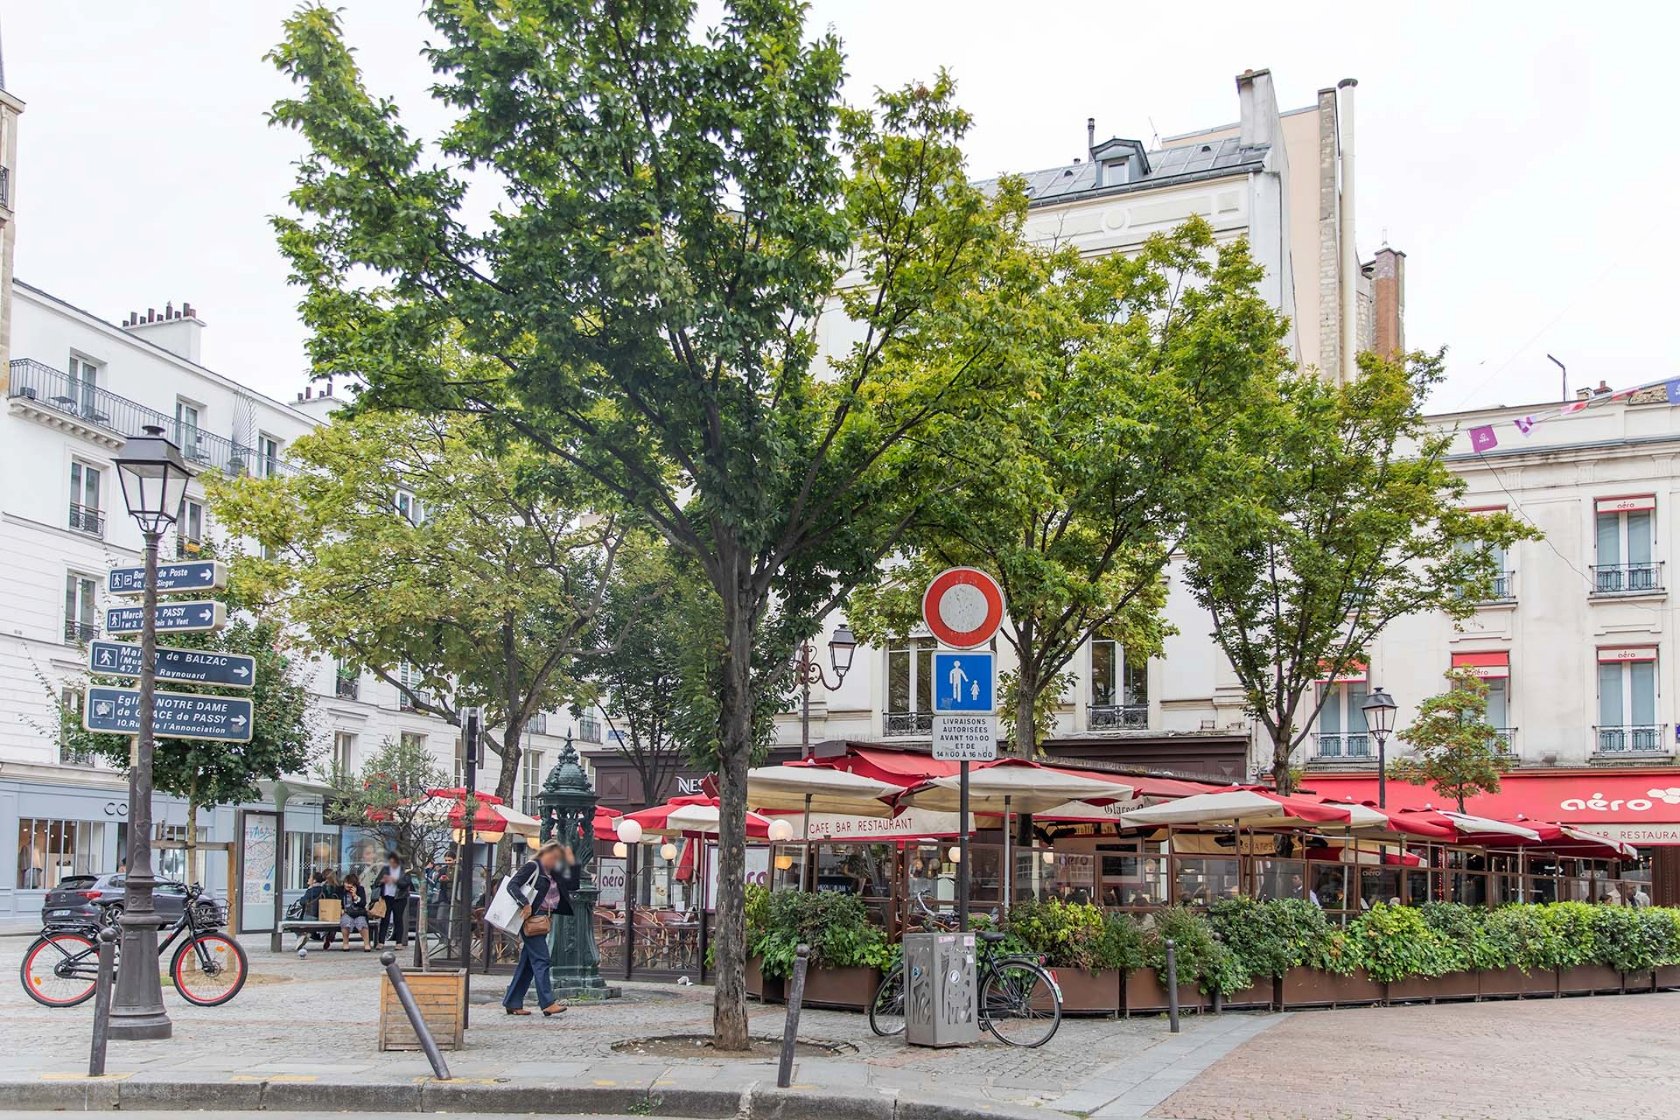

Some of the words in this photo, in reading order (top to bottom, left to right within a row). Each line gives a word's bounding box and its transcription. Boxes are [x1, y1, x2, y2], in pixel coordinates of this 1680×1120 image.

[133, 570, 145, 579] Bur
[158, 569, 167, 578] de
[169, 568, 188, 577] Poste
[122, 611, 144, 620] March
[162, 607, 186, 618] PASSY
[176, 618, 189, 626] Vent
[120, 646, 160, 660] Main
[166, 653, 179, 662] de
[185, 654, 228, 667] BALZAC
[159, 668, 206, 681] Raynouard
[117, 695, 140, 707] Egli
[156, 698, 192, 711] NOTRE
[196, 702, 229, 713] DAME
[116, 707, 131, 717] de
[135, 709, 173, 721] GACE
[176, 711, 189, 721] de
[193, 714, 227, 725] PASSY
[163, 722, 226, 734] l'Annonciation
[1560, 792, 1653, 811] aéro
[836, 821, 852, 833] BAR
[858, 818, 912, 832] RESTAURANT
[602, 868, 624, 888] aéro
